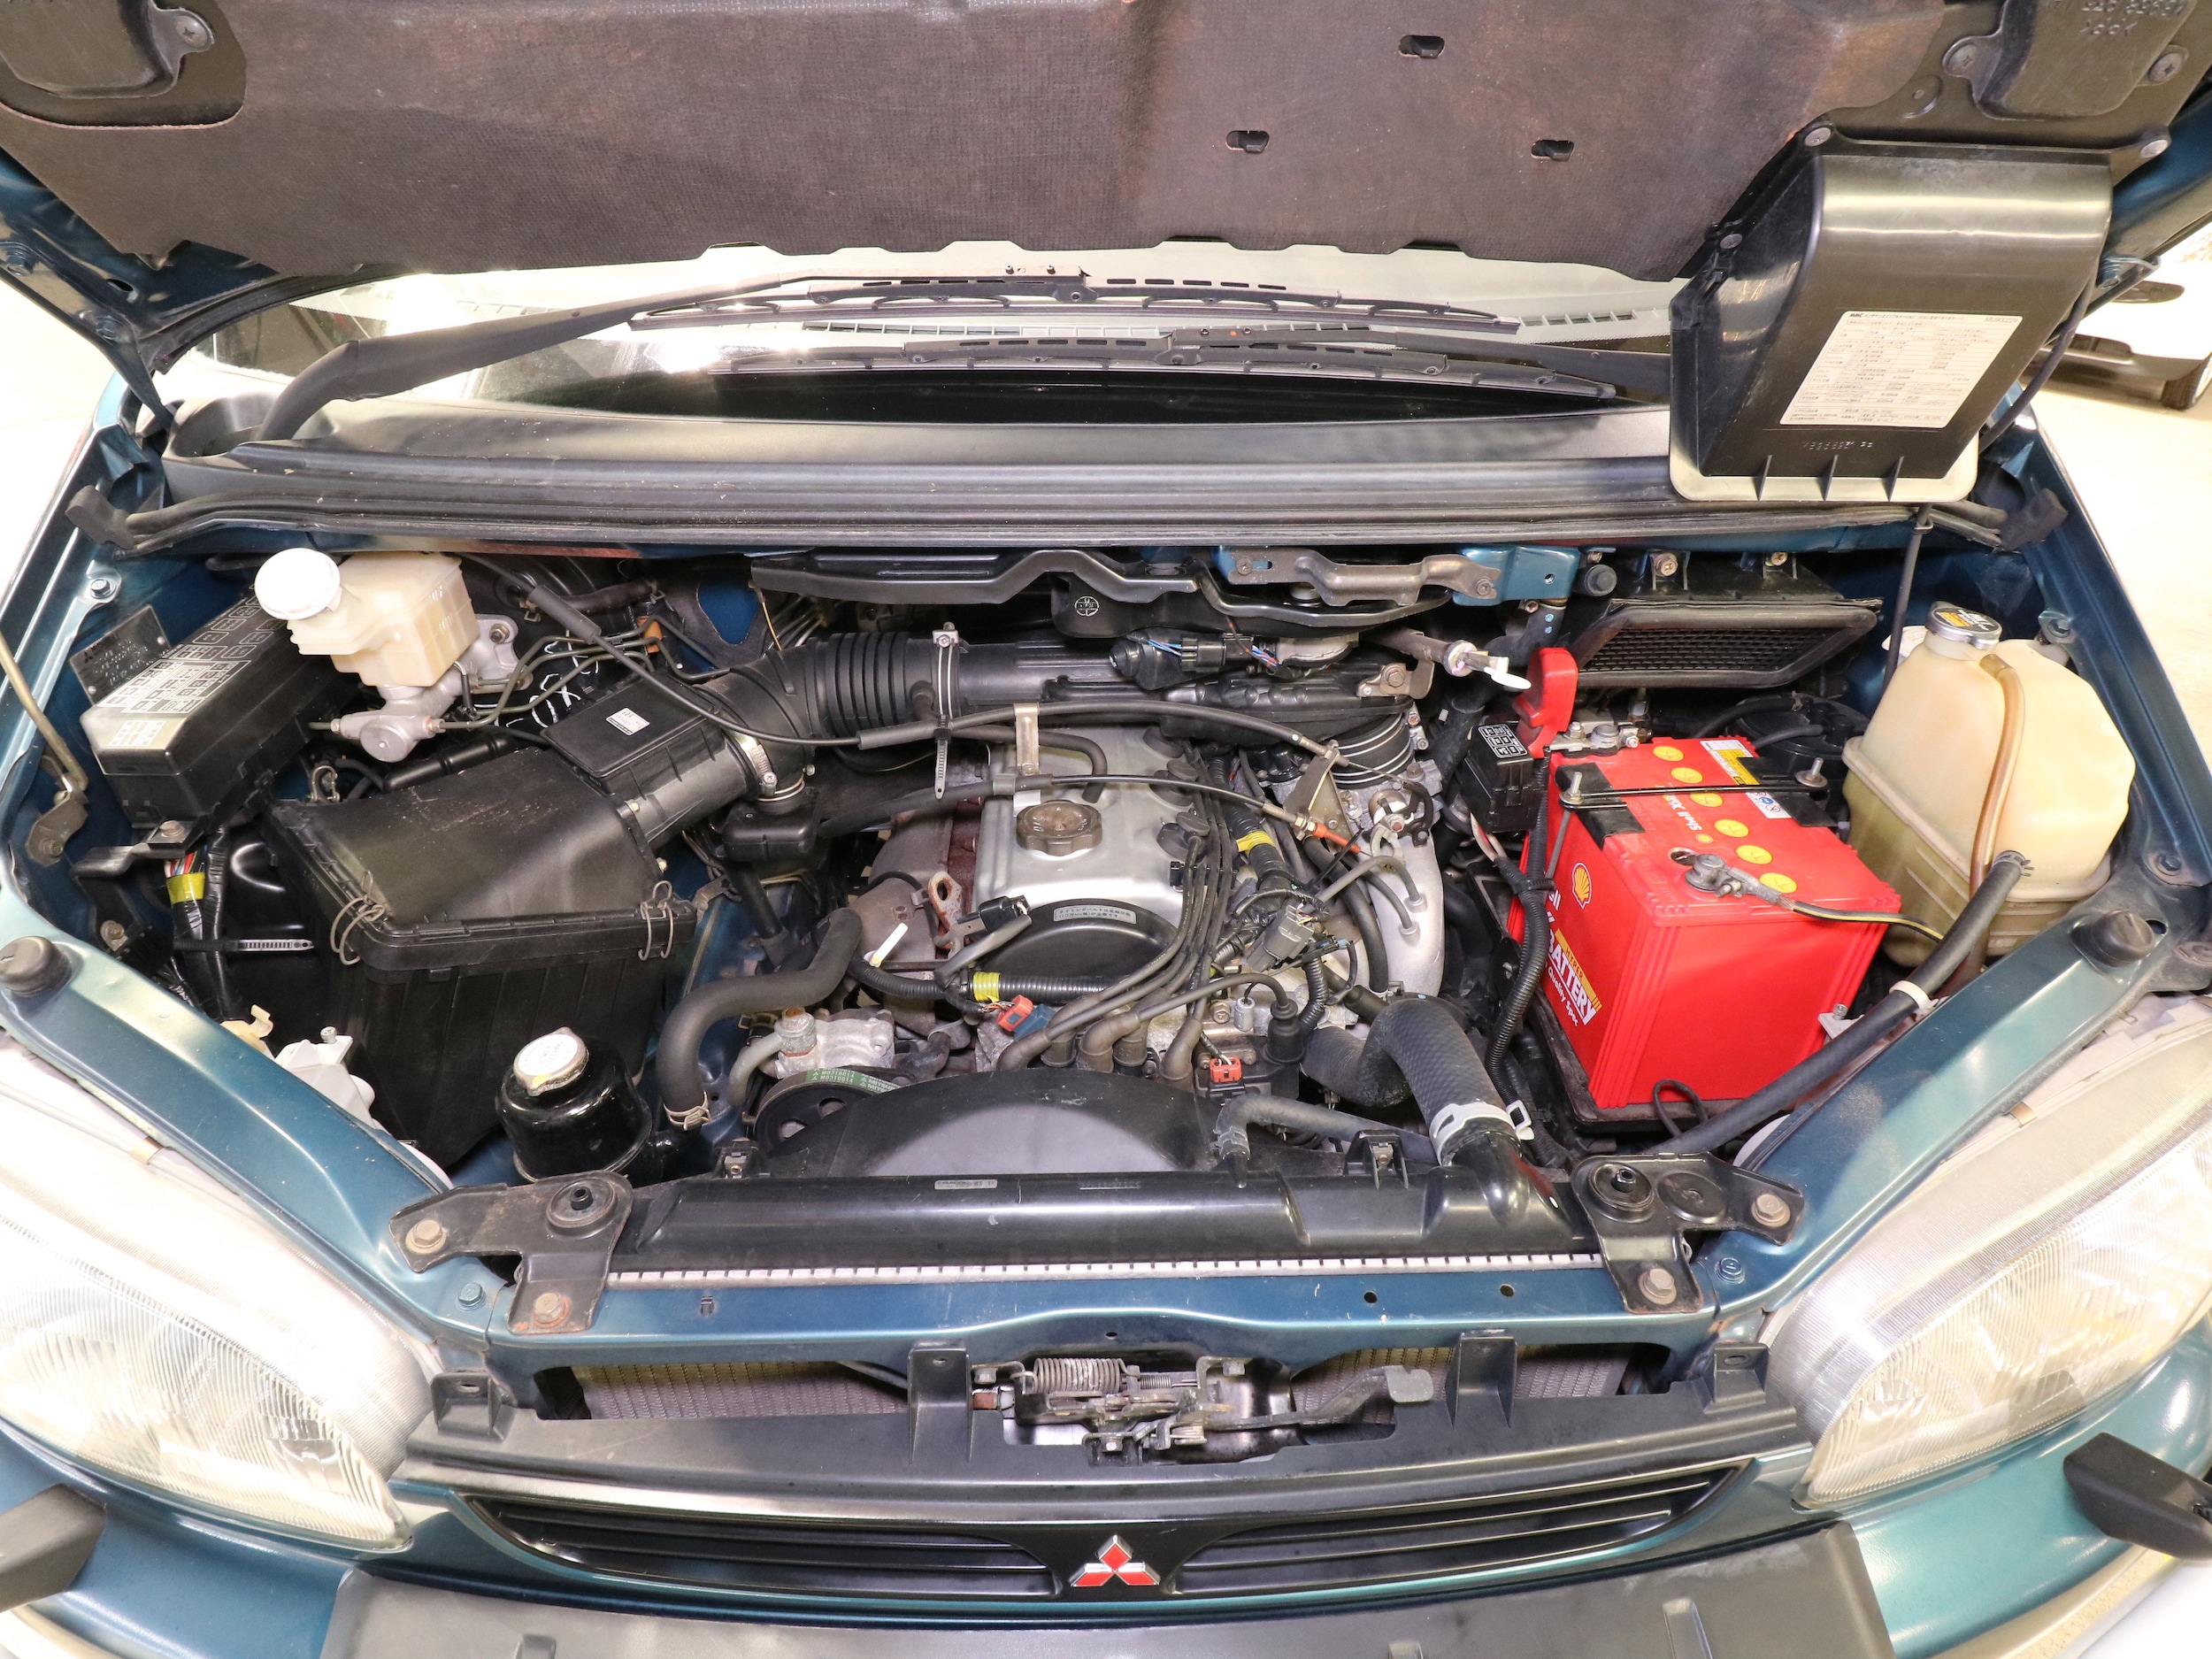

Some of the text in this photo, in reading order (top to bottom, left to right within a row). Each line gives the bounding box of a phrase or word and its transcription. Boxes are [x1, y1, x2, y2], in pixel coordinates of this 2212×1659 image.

[1677, 811, 1703, 831] Shell
[1565, 947, 1584, 981] HYPER
[1548, 965, 1579, 1026] Quality Spec
